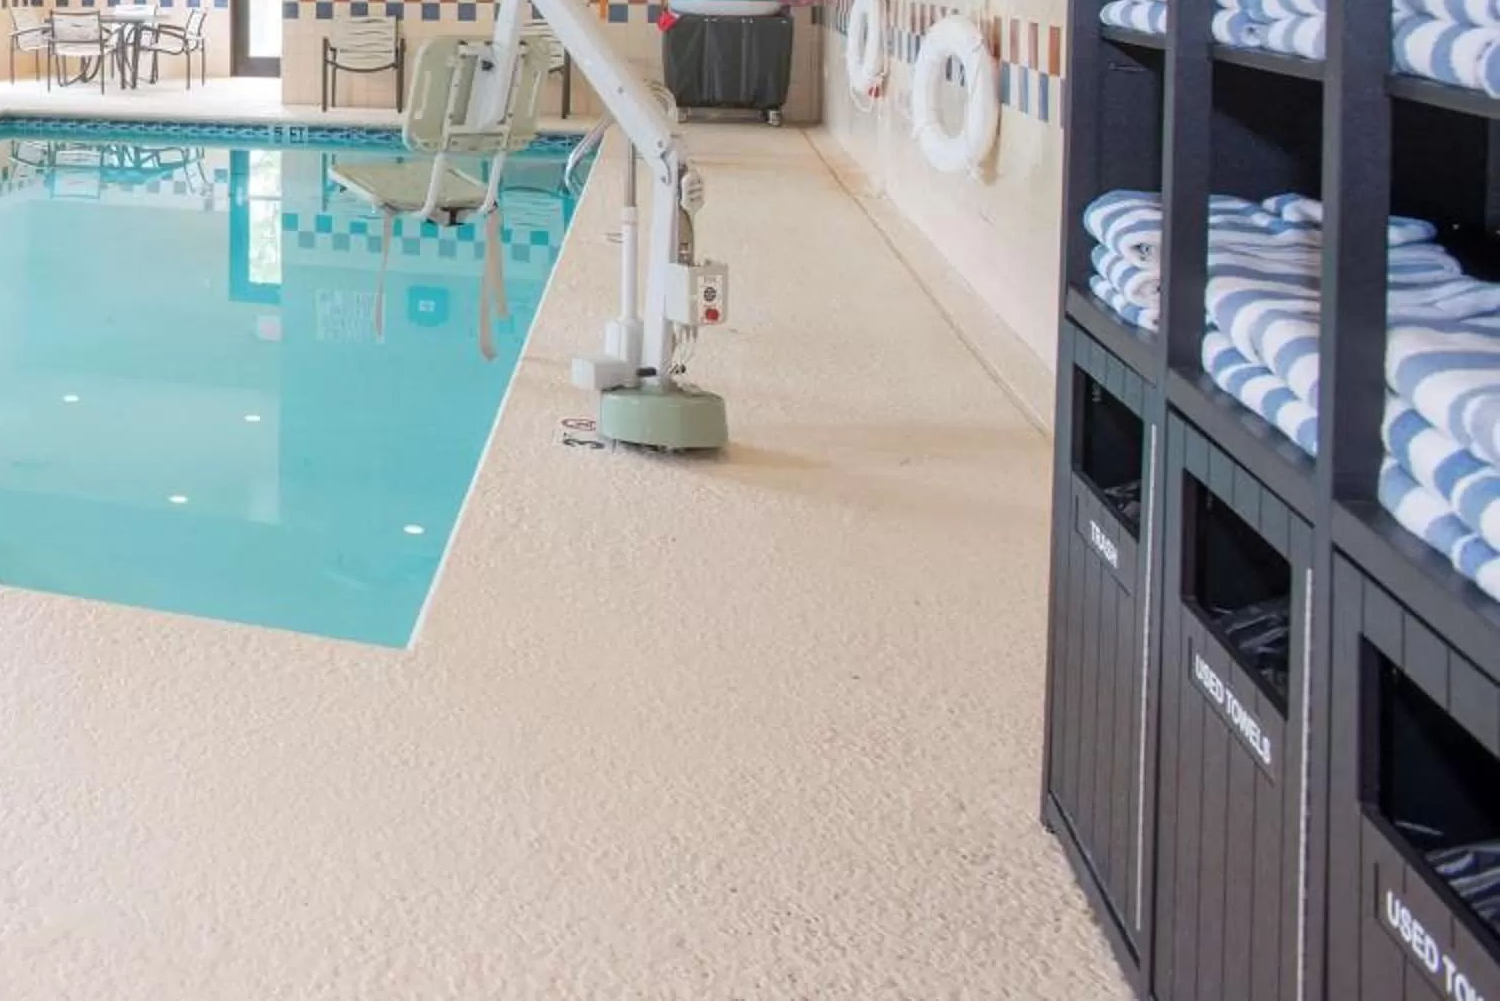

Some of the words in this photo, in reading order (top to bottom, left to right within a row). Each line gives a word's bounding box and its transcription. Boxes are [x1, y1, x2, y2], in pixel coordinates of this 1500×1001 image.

[1195, 654, 1224, 704] USED
[1225, 687, 1271, 765] TOWELS
[1386, 888, 1438, 973] USED
